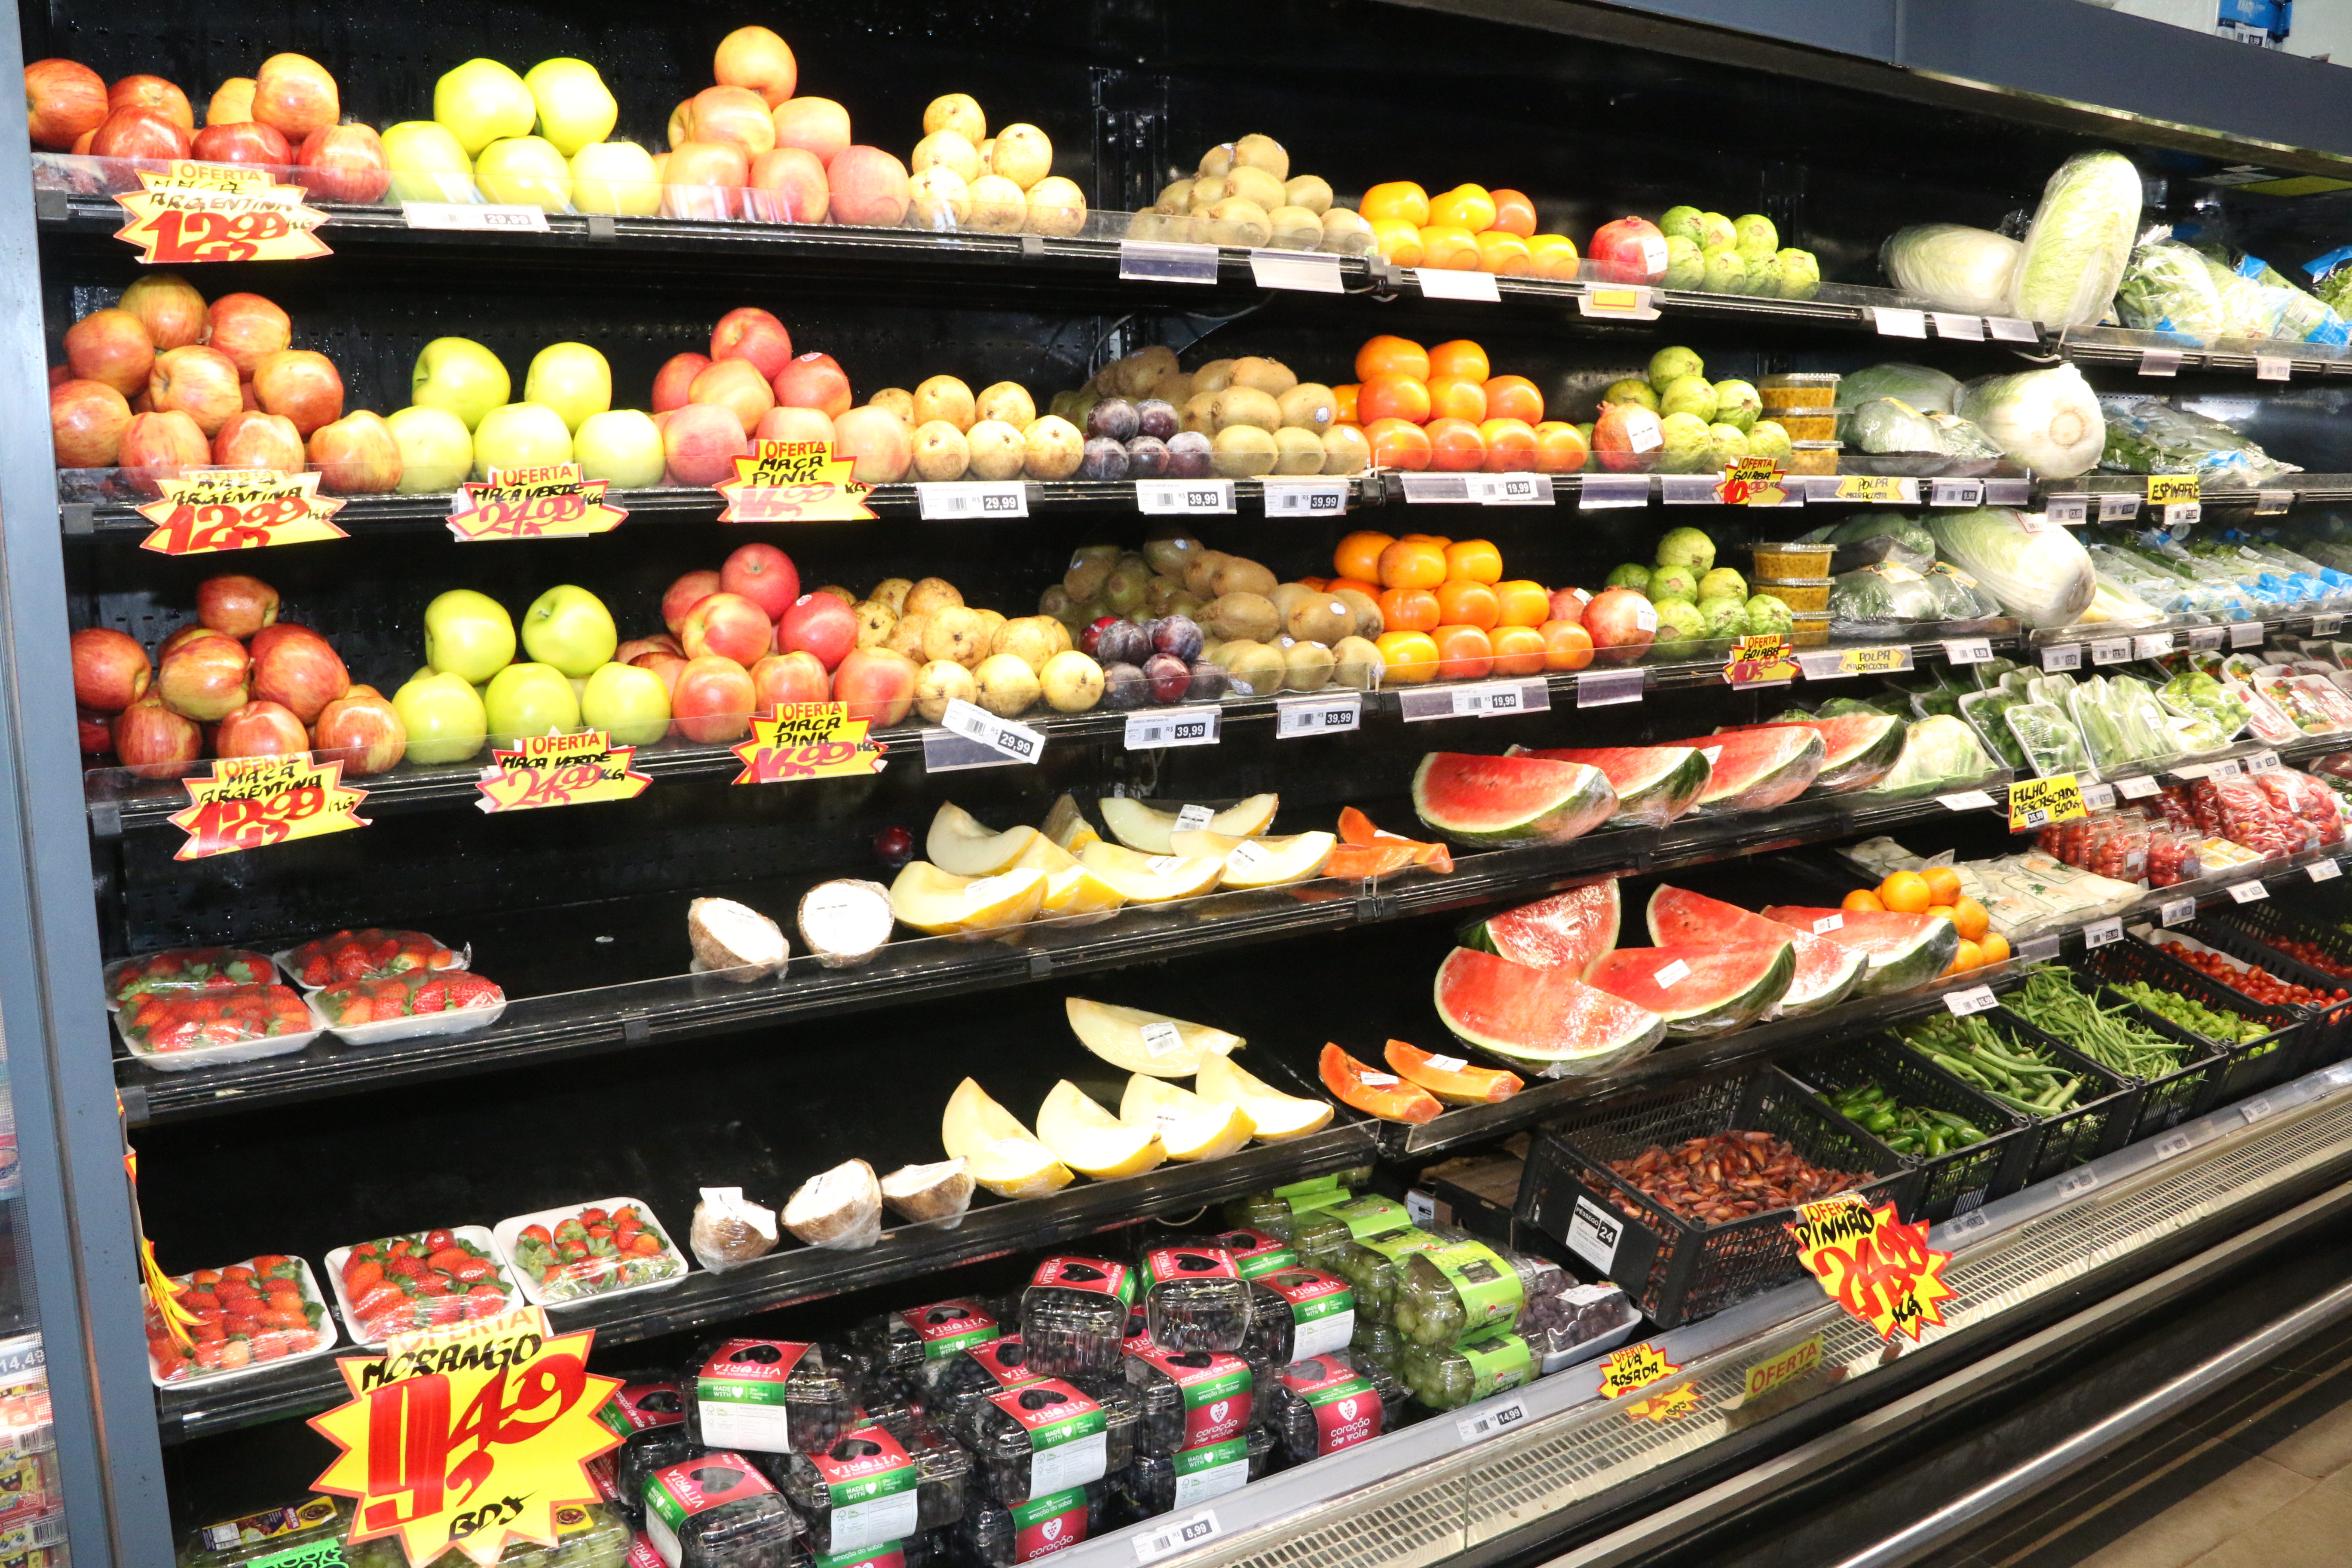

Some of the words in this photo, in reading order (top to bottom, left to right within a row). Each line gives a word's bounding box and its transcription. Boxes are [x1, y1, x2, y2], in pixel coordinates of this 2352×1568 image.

[180, 162, 261, 181] OFERTA
[487, 214, 529, 224] 29,99
[766, 441, 826, 459] OFERTA
[1742, 458, 1772, 469] OFERTA
[503, 466, 573, 486] OFERTA
[753, 469, 818, 485] PINK
[1733, 470, 1771, 481] GOIABA
[845, 483, 867, 493] KG
[1507, 483, 1529, 494] 19,99
[1857, 478, 1888, 491] POLPA
[581, 493, 604, 505] KG
[985, 496, 1016, 510] 29,99
[1189, 493, 1217, 506] 39,99
[1312, 496, 1337, 508] 39,99
[1963, 492, 1975, 500] 9,99
[1749, 635, 1777, 648] OFERTA
[1743, 646, 1780, 660] GOIABA
[1859, 650, 1891, 662] POLPA
[1493, 695, 1515, 707] 19,99
[782, 702, 842, 721] OFERTA
[1327, 713, 1351, 724] 39,99
[1176, 725, 1204, 738] 39,99
[533, 734, 600, 754] OFERTA
[774, 731, 834, 749] PINK
[856, 742, 879, 752] KG
[990, 727, 998, 735] R$
[1000, 733, 1031, 754] 29,99
[224, 753, 299, 778] OFERTA
[600, 769, 625, 781] KG
[200, 774, 323, 804] ARGENTINA
[2029, 811, 2044, 822] 35,99
[1978, 996, 1993, 1005] 16,99
[1576, 1207, 1599, 1226] PÉSSEGO
[1807, 1198, 1858, 1222] OFERTA
[1599, 1226, 1614, 1243] 24
[400, 1310, 533, 1353] OFERTA
[939, 1341, 956, 1351] MADE
[1614, 1343, 1646, 1363] OFERTA
[362, 1333, 542, 1392] MORANGO
[1619, 1354, 1643, 1372] UVA
[1751, 1341, 1818, 1394] OFERTA
[1180, 1369, 1213, 1383] coração
[1224, 1361, 1242, 1370] vale
[1611, 1362, 1659, 1387] ROSADA
[1297, 1381, 1326, 1393] coração
[1337, 1372, 1354, 1382] vale
[1198, 1390, 1219, 1401] emoção
[1225, 1383, 1240, 1393] sabor
[633, 1415, 645, 1428] vale
[1498, 1409, 1520, 1423] 14,99
[1045, 1428, 1062, 1437] MADE
[1196, 1418, 1238, 1438] coração
[1211, 1428, 1233, 1440] vale
[1331, 1417, 1370, 1438] coração
[1346, 1427, 1369, 1442] vale
[1046, 1434, 1063, 1443] WITH
[1187, 1454, 1204, 1462] MADE
[1189, 1459, 1204, 1467] WITH
[651, 1486, 661, 1497] MADE
[846, 1485, 865, 1494] MADE
[847, 1491, 865, 1500] WITH
[647, 1493, 658, 1504] WITH
[1029, 1508, 1050, 1520] emoção
[1058, 1498, 1073, 1510] sabor
[1186, 1523, 1207, 1538] 8,99
[833, 1551, 857, 1562] emoção
[867, 1543, 884, 1553] sabor
[1029, 1534, 1074, 1558] coração
